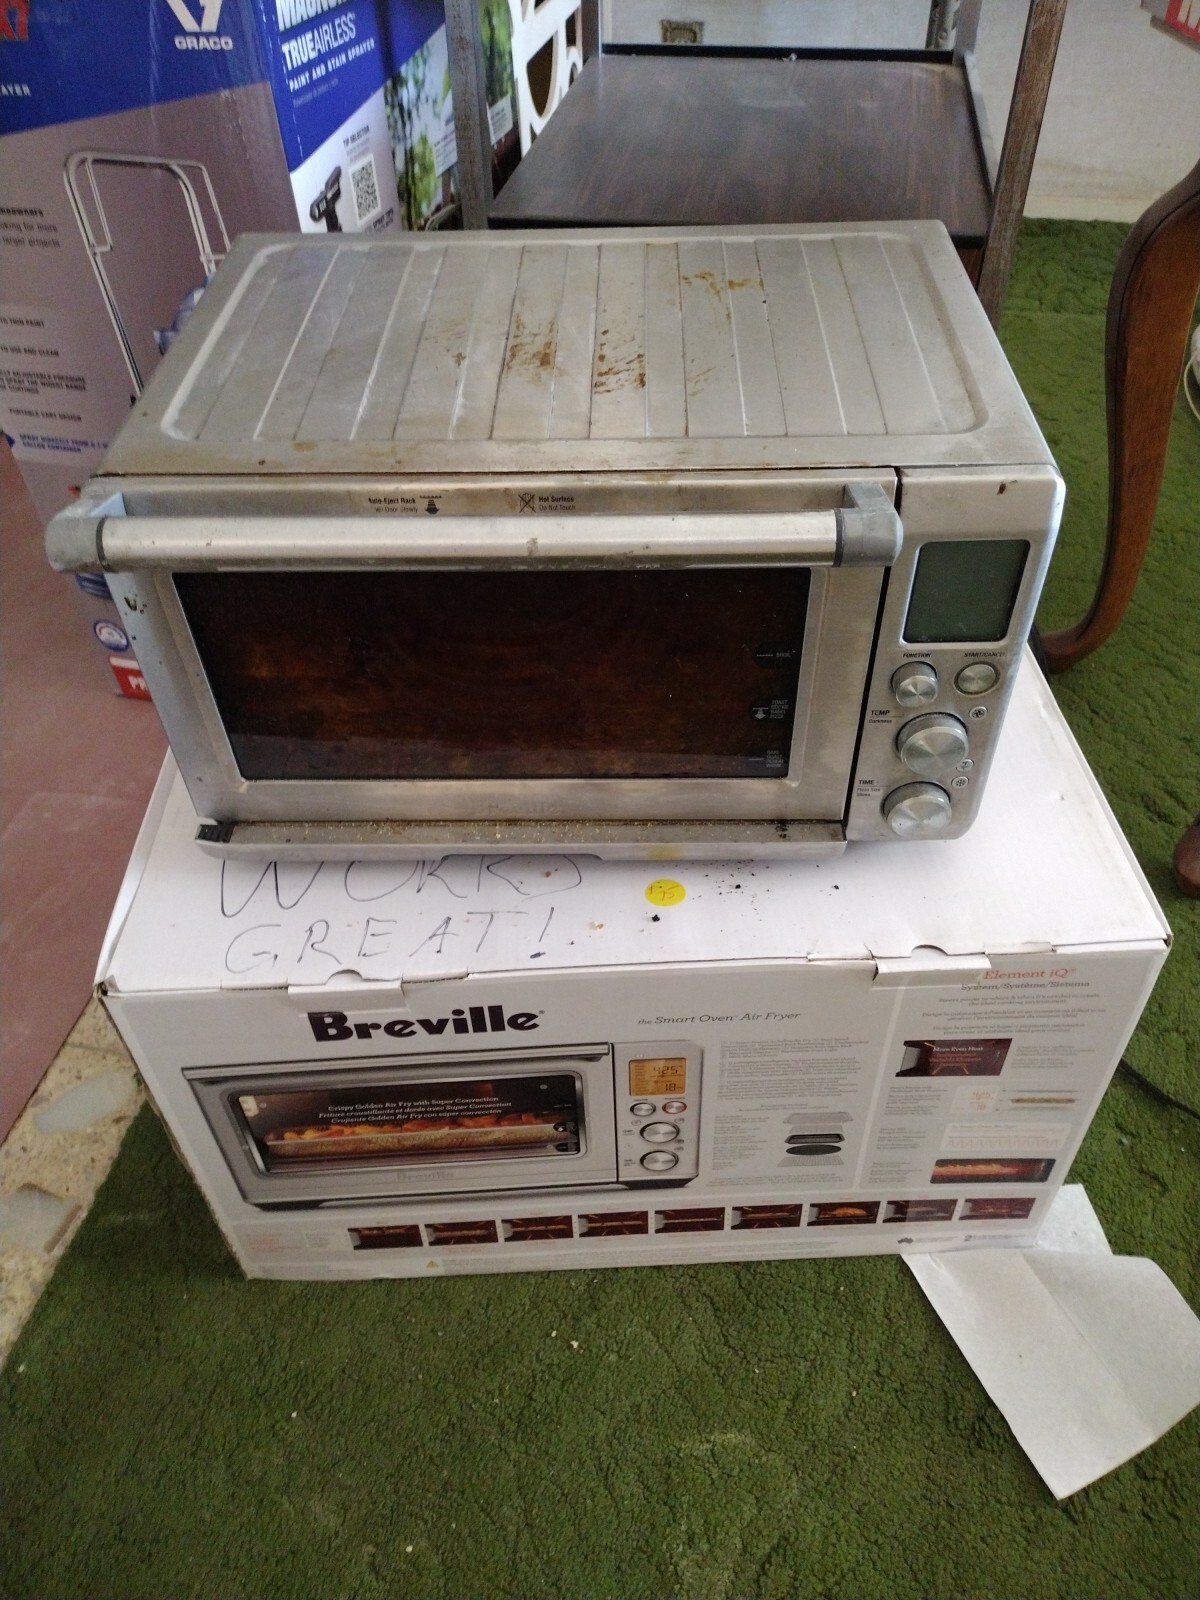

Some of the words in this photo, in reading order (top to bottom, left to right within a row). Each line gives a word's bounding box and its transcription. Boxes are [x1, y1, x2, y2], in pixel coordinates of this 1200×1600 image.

[174, 36, 233, 50] GRACO
[281, 12, 356, 71] TRUEAIRLESS
[289, 69, 310, 93] PAINT
[312, 62, 326, 81] AND
[327, 52, 346, 72] STAIN
[347, 37, 375, 61] SPRAYER
[538, 495, 549, 503] Hot
[550, 495, 575, 503] Surface
[549, 503, 559, 511] Not
[559, 503, 576, 511] Touch
[983, 970, 1045, 980] Element
[1049, 968, 1069, 979] iQ
[306, 1003, 541, 1043] Breville
[655, 1016, 696, 1024] Smart
[699, 1014, 734, 1023] Oven
[739, 1012, 763, 1021] Air
[764, 1011, 802, 1021] Fryer
[455, 1096, 499, 1104] Convection
